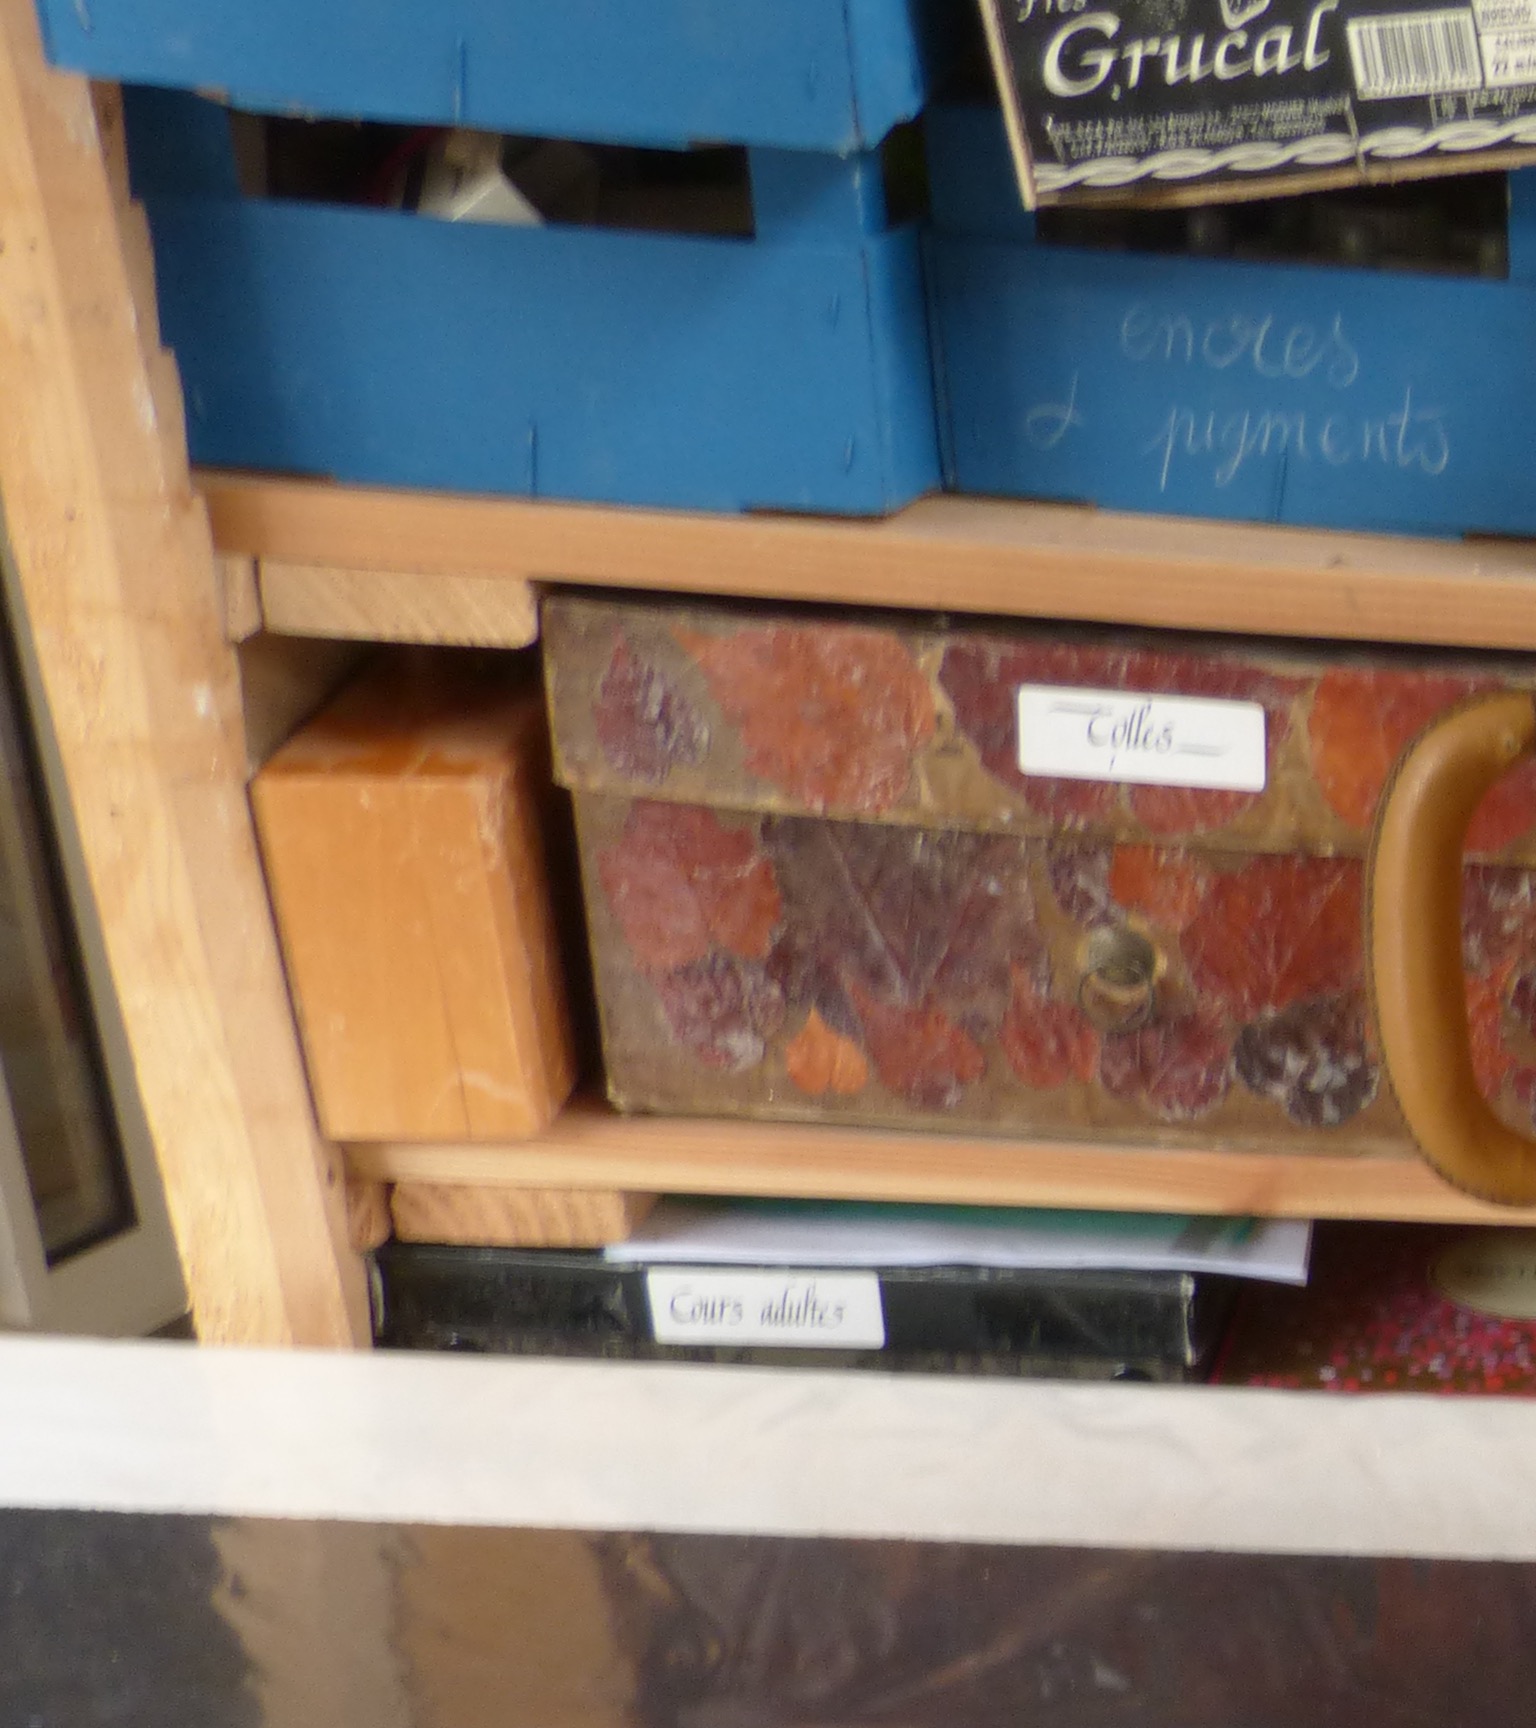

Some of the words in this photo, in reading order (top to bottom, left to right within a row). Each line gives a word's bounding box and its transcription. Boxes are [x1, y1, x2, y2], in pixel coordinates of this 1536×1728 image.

[1043, 1, 1337, 98] Grucal
[1138, 385, 1450, 494] pigments
[670, 1283, 744, 1325] Cours
[759, 1279, 846, 1329] adultes
